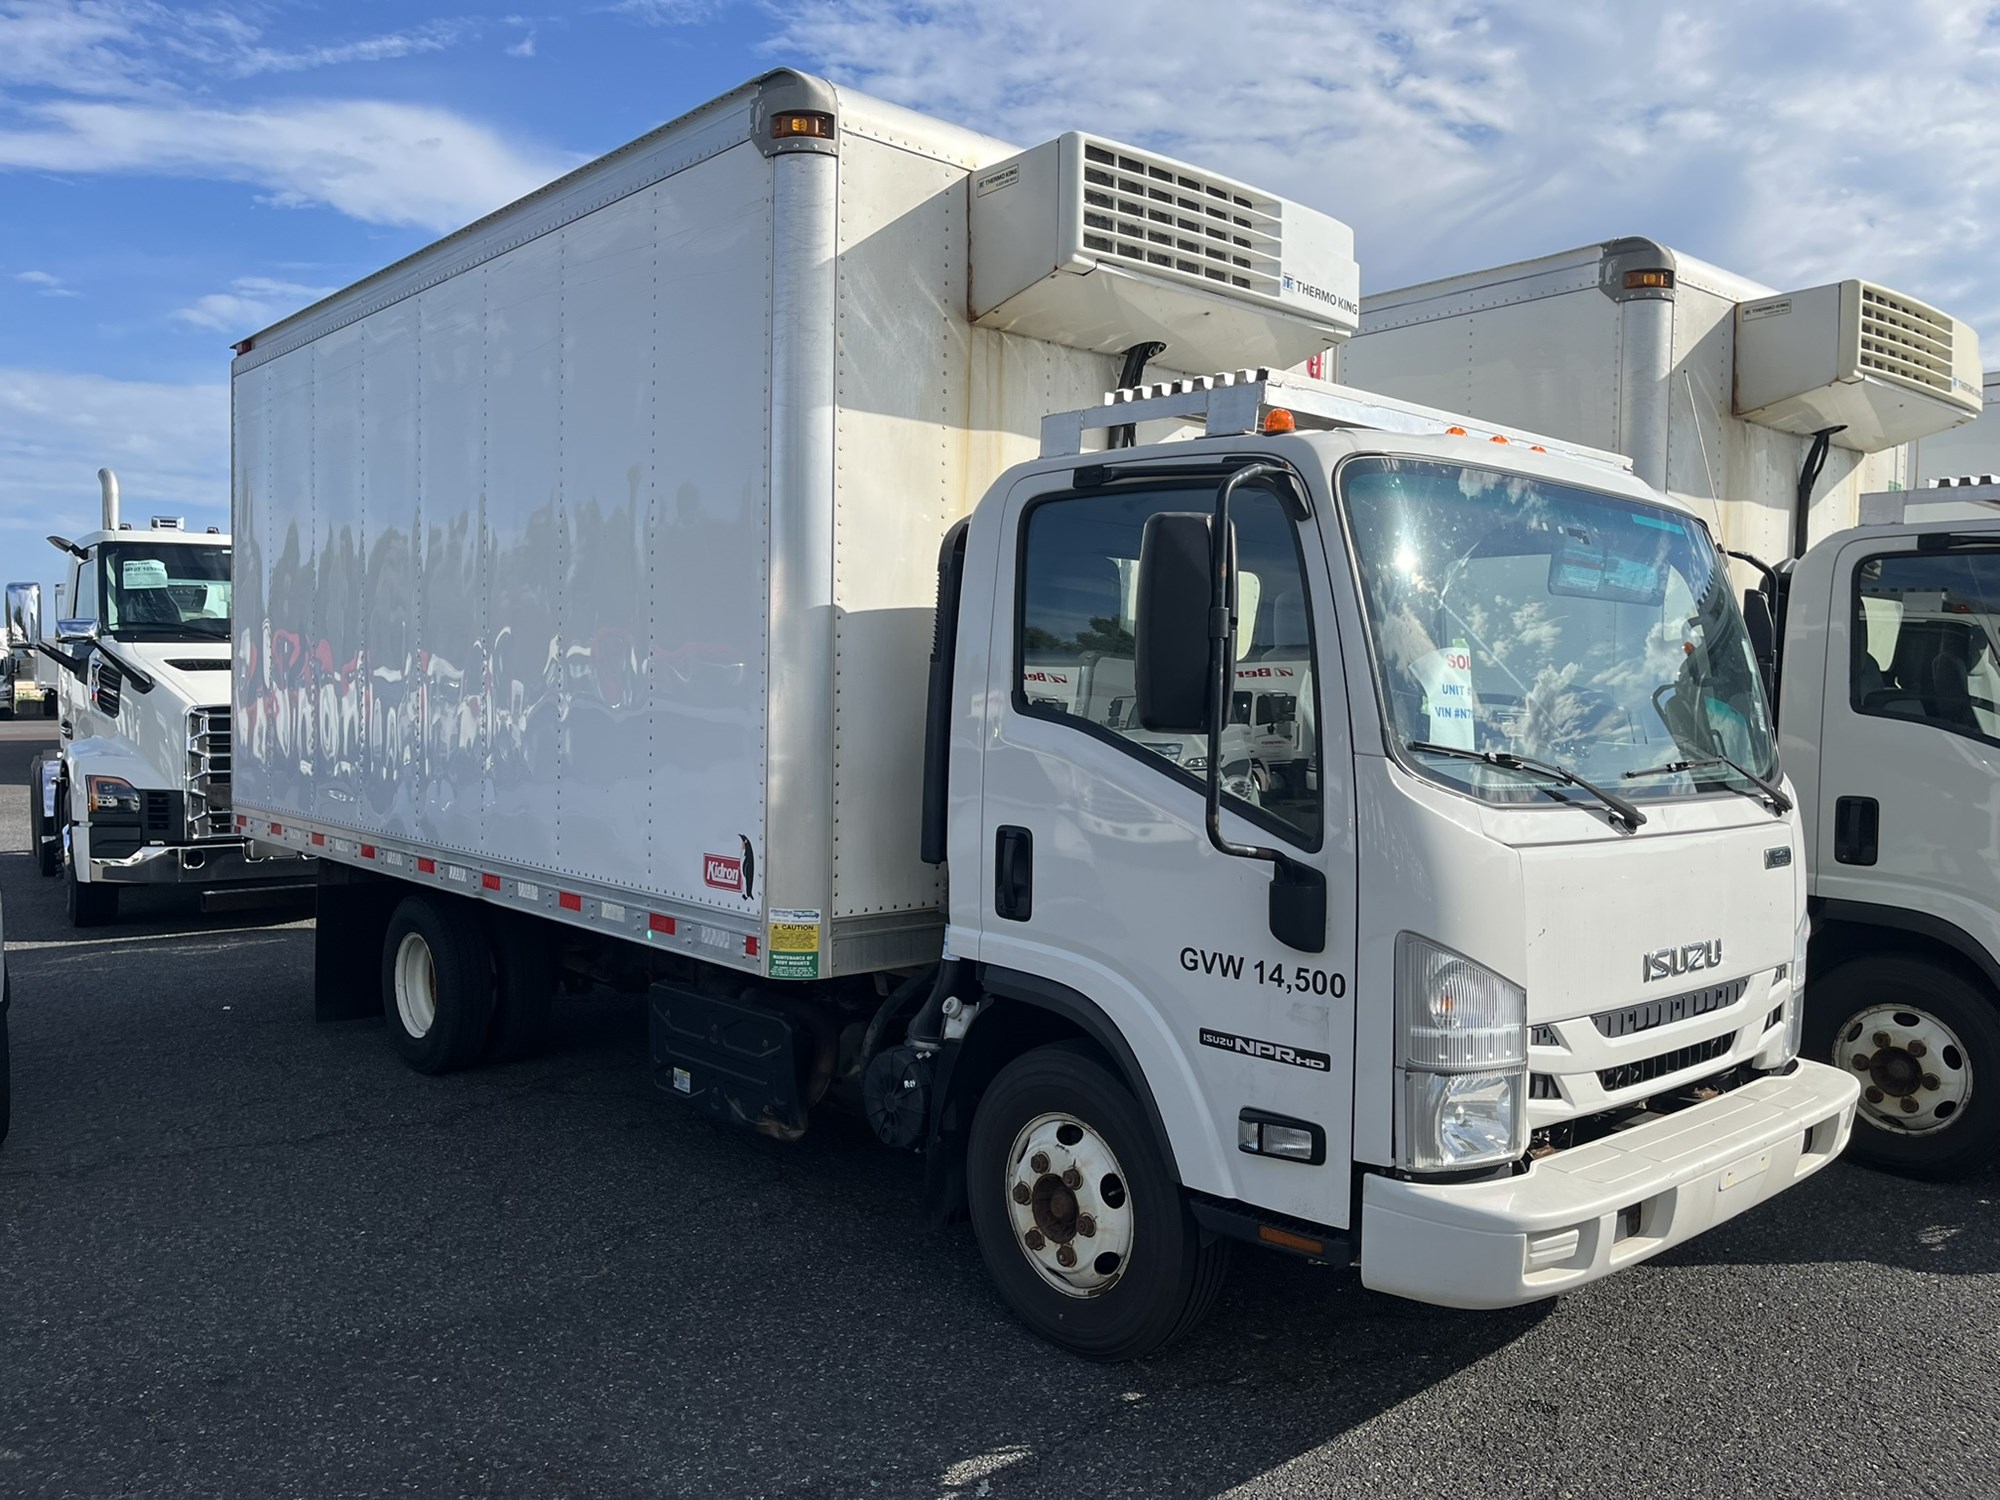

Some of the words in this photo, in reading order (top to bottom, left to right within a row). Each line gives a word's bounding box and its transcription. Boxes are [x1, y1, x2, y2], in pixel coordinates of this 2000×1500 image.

[985, 172, 1005, 186] THERMO
[1005, 168, 1018, 178] KING
[1296, 280, 1337, 306] THERMO
[1337, 296, 1358, 316] KING
[1442, 684, 1465, 696] UNIT
[1434, 706, 1452, 719] VIN
[1454, 708, 1473, 719] #N7
[707, 860, 739, 885] Kidron
[1643, 937, 1722, 983] ISUZU
[1180, 947, 1244, 980] GVW
[1254, 960, 1346, 999] 14,500
[1203, 1033, 1234, 1047] ISUZU
